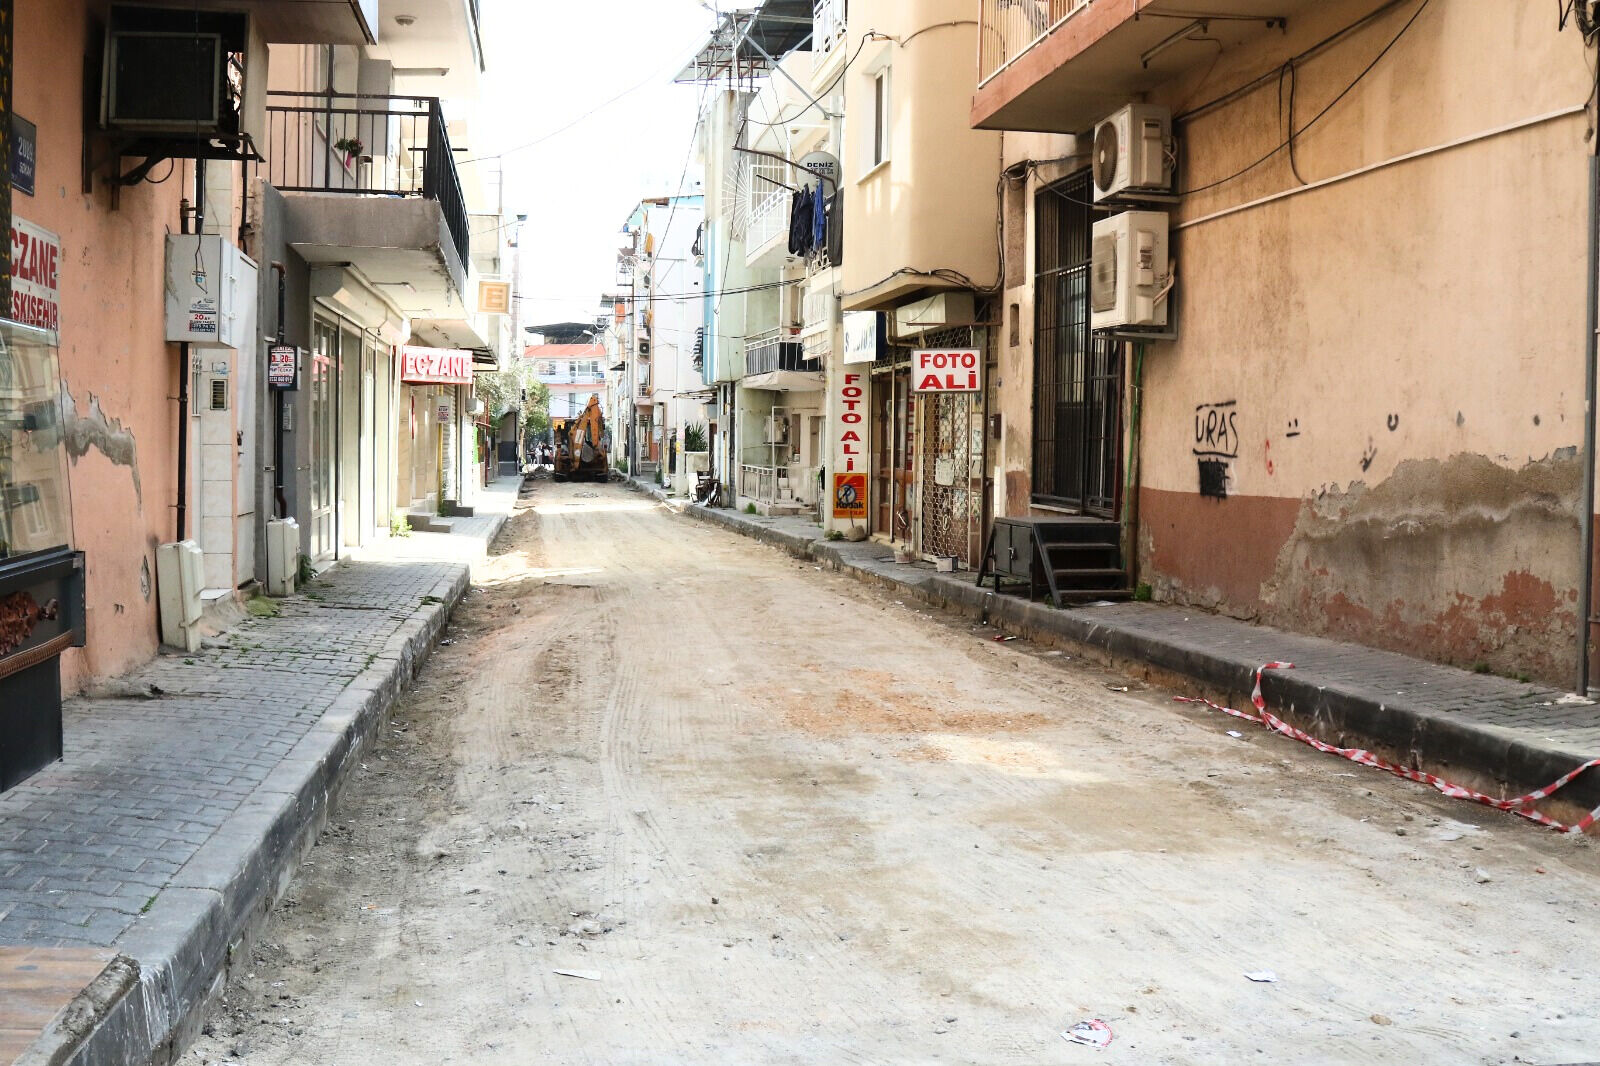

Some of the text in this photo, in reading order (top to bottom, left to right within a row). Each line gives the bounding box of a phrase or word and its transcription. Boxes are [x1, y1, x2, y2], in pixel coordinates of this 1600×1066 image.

[10, 227, 57, 290] CZANE
[405, 353, 472, 378] ECZANE
[920, 353, 976, 369] FOTO
[918, 370, 977, 390] ALİ
[840, 374, 863, 472] FOTO ALİ
